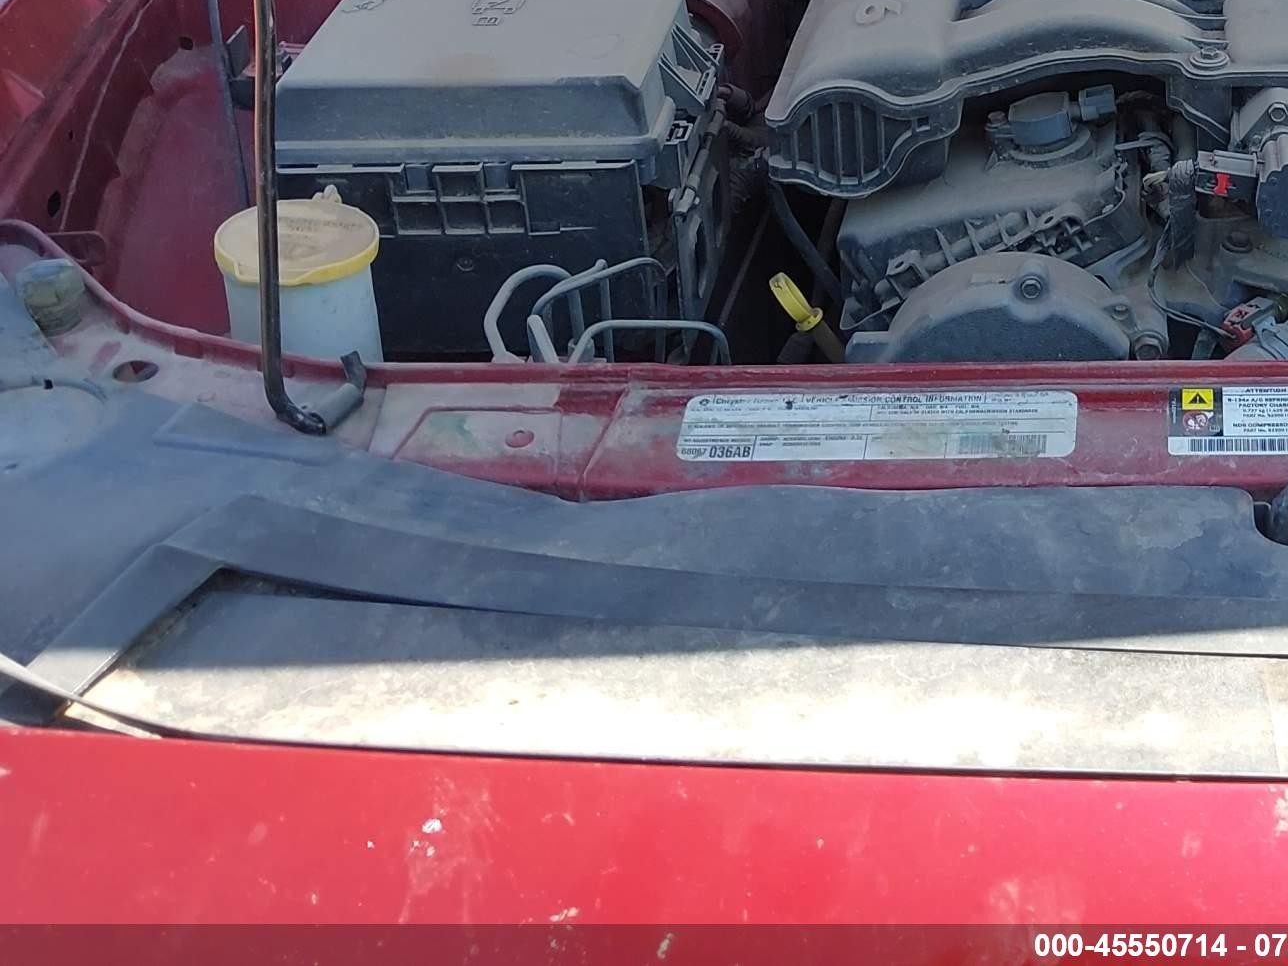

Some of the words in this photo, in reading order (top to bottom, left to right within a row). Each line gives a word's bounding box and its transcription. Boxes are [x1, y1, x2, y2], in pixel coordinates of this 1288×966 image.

[885, 393, 923, 404] CONTROL
[925, 393, 983, 404] INFORMATION
[709, 445, 751, 458] 036AB
